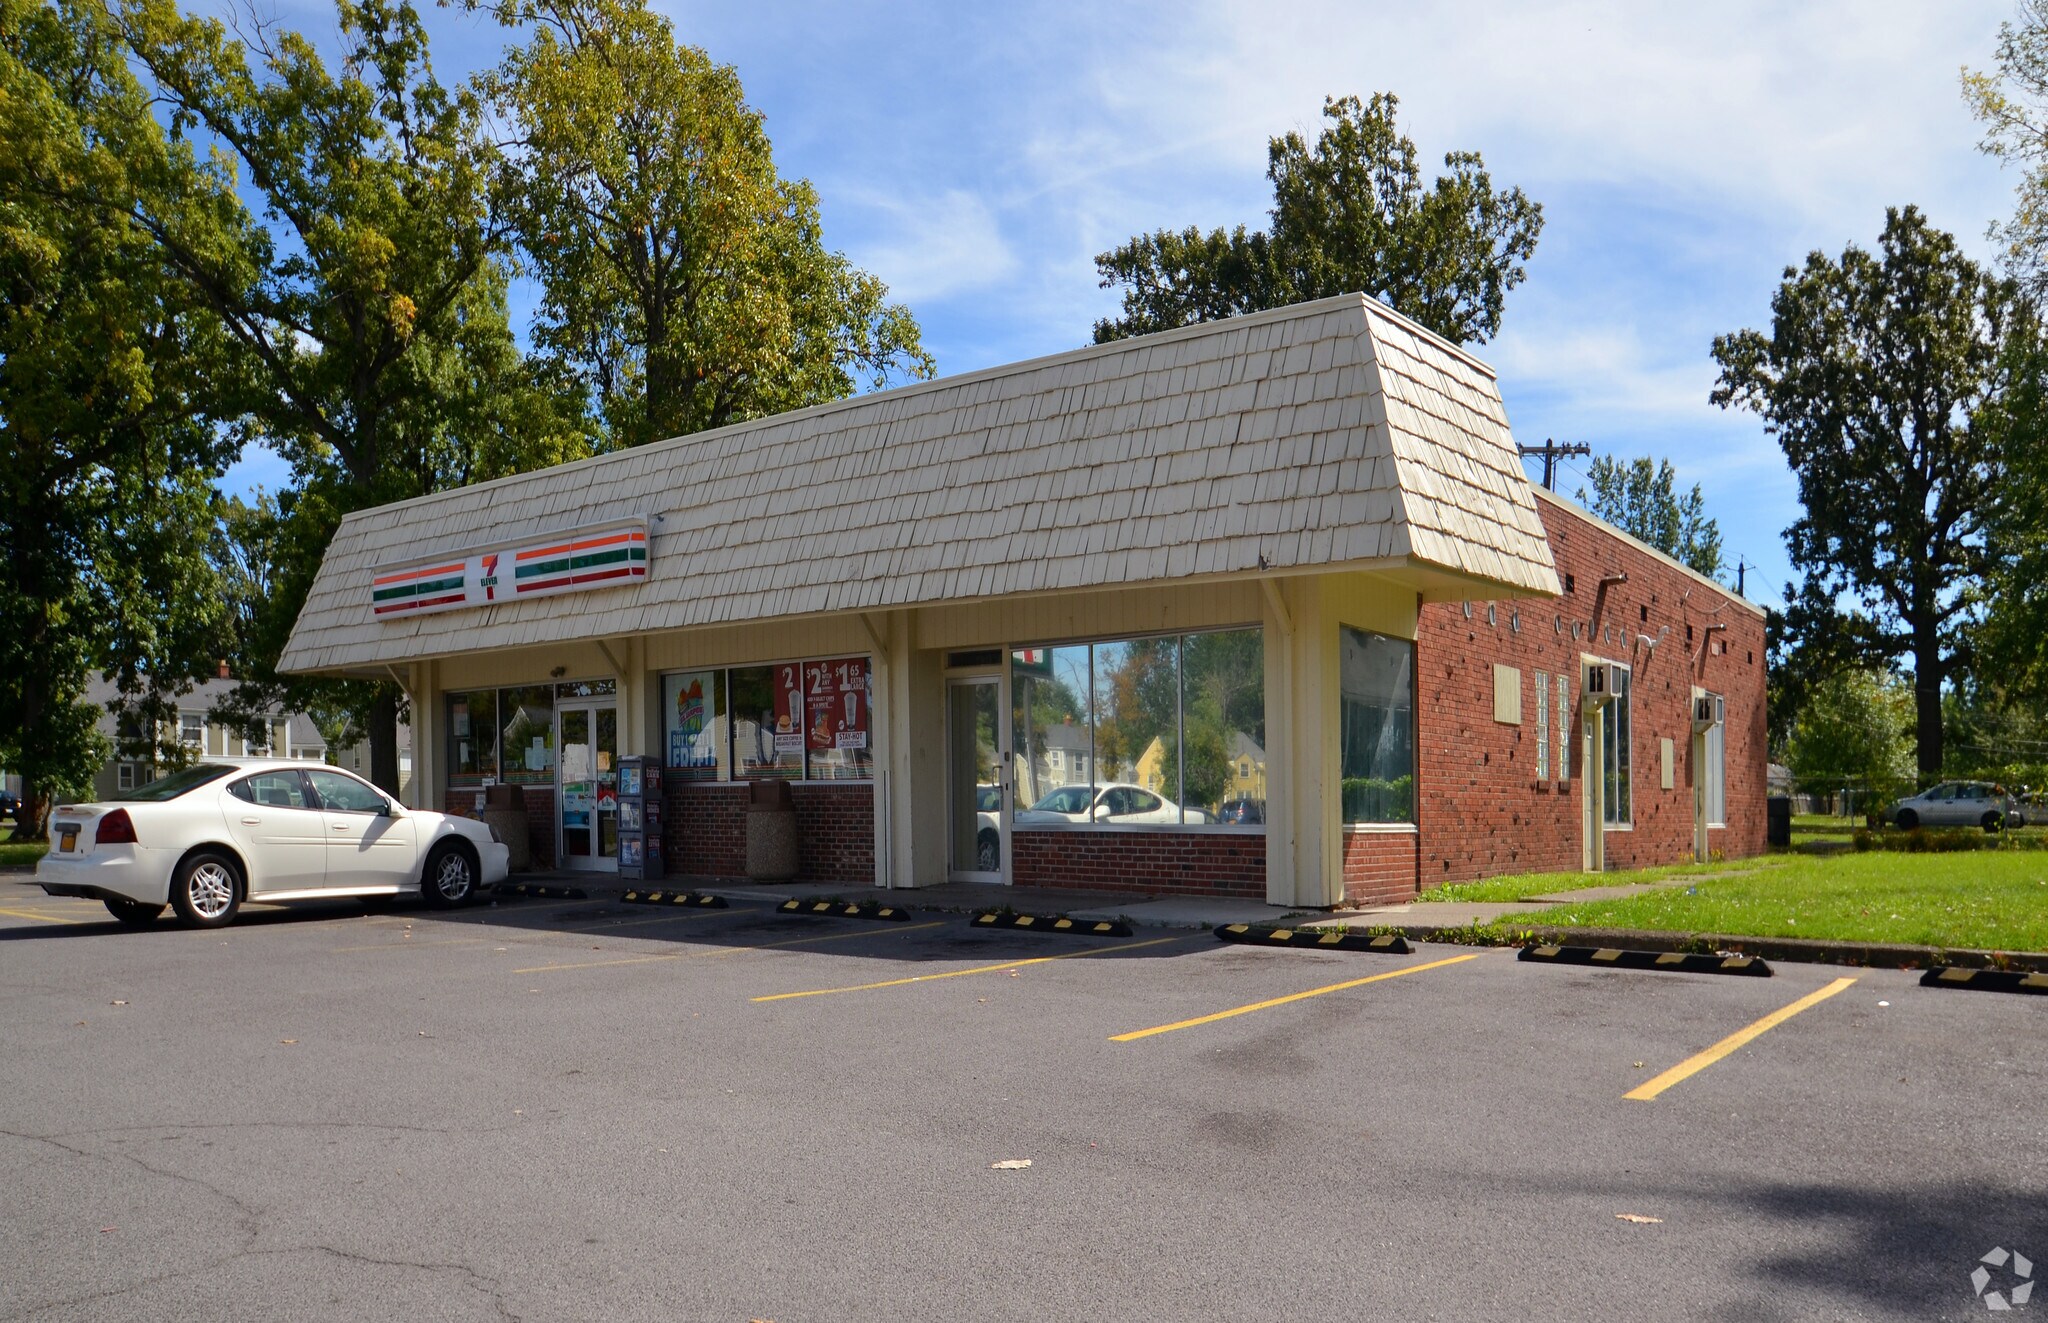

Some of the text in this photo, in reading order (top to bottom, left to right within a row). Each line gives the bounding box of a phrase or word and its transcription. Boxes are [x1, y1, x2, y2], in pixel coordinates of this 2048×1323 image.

[482, 553, 498, 600] 7
[850, 665, 859, 676] 65
[807, 667, 821, 694] $2
[850, 677, 865, 685] EXTRA
[850, 683, 865, 691] LARGE
[673, 733, 684, 746] BUY
[839, 732, 863, 741] STAY-HOT
